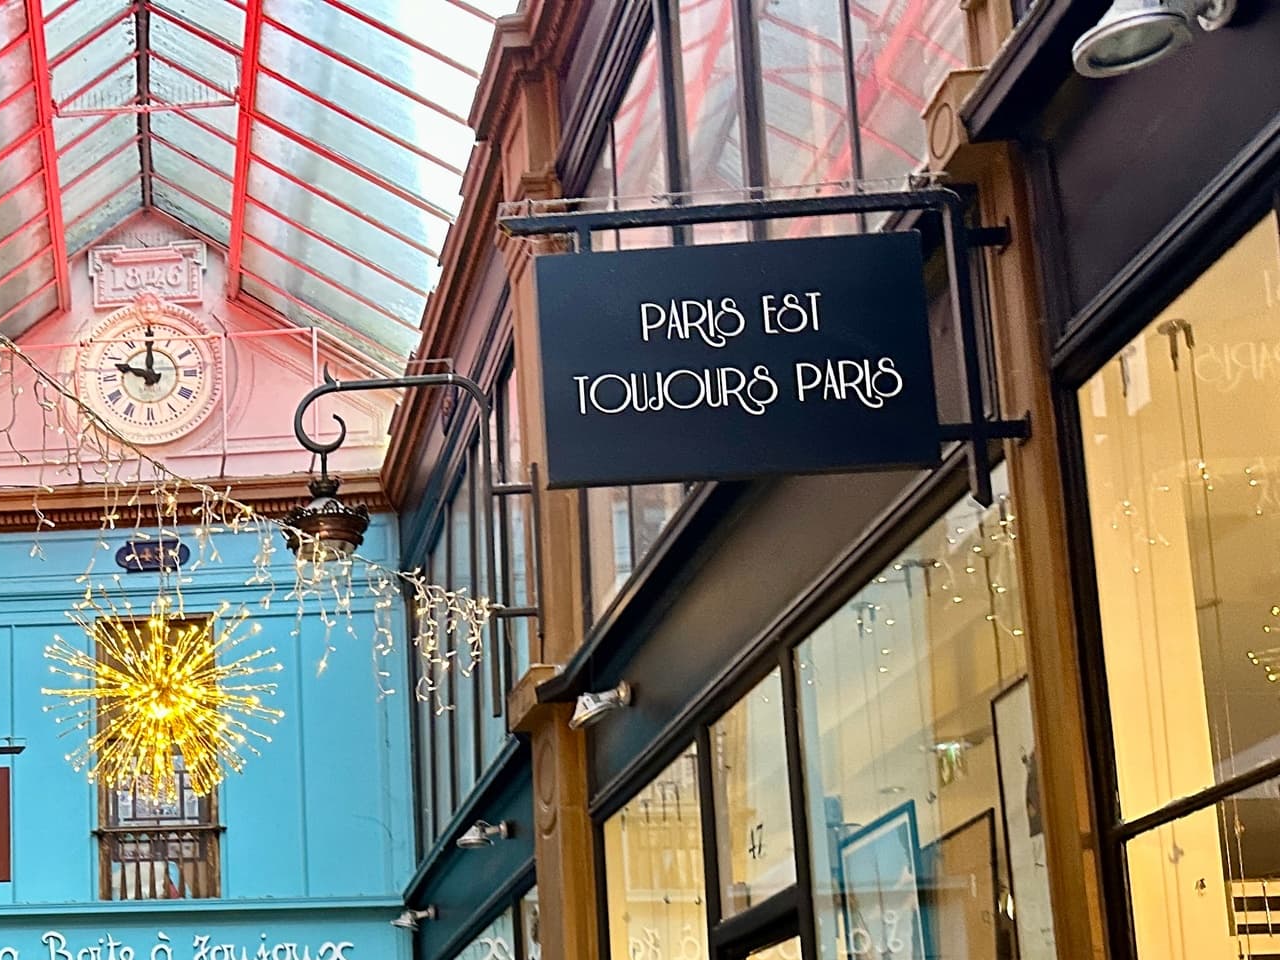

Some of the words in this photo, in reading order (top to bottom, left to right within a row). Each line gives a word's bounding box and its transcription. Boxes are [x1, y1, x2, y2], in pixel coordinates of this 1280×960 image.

[640, 297, 745, 348] PARIS
[762, 292, 821, 334] EST
[573, 365, 778, 415] TOUJOURS
[796, 357, 903, 408] PARIS
